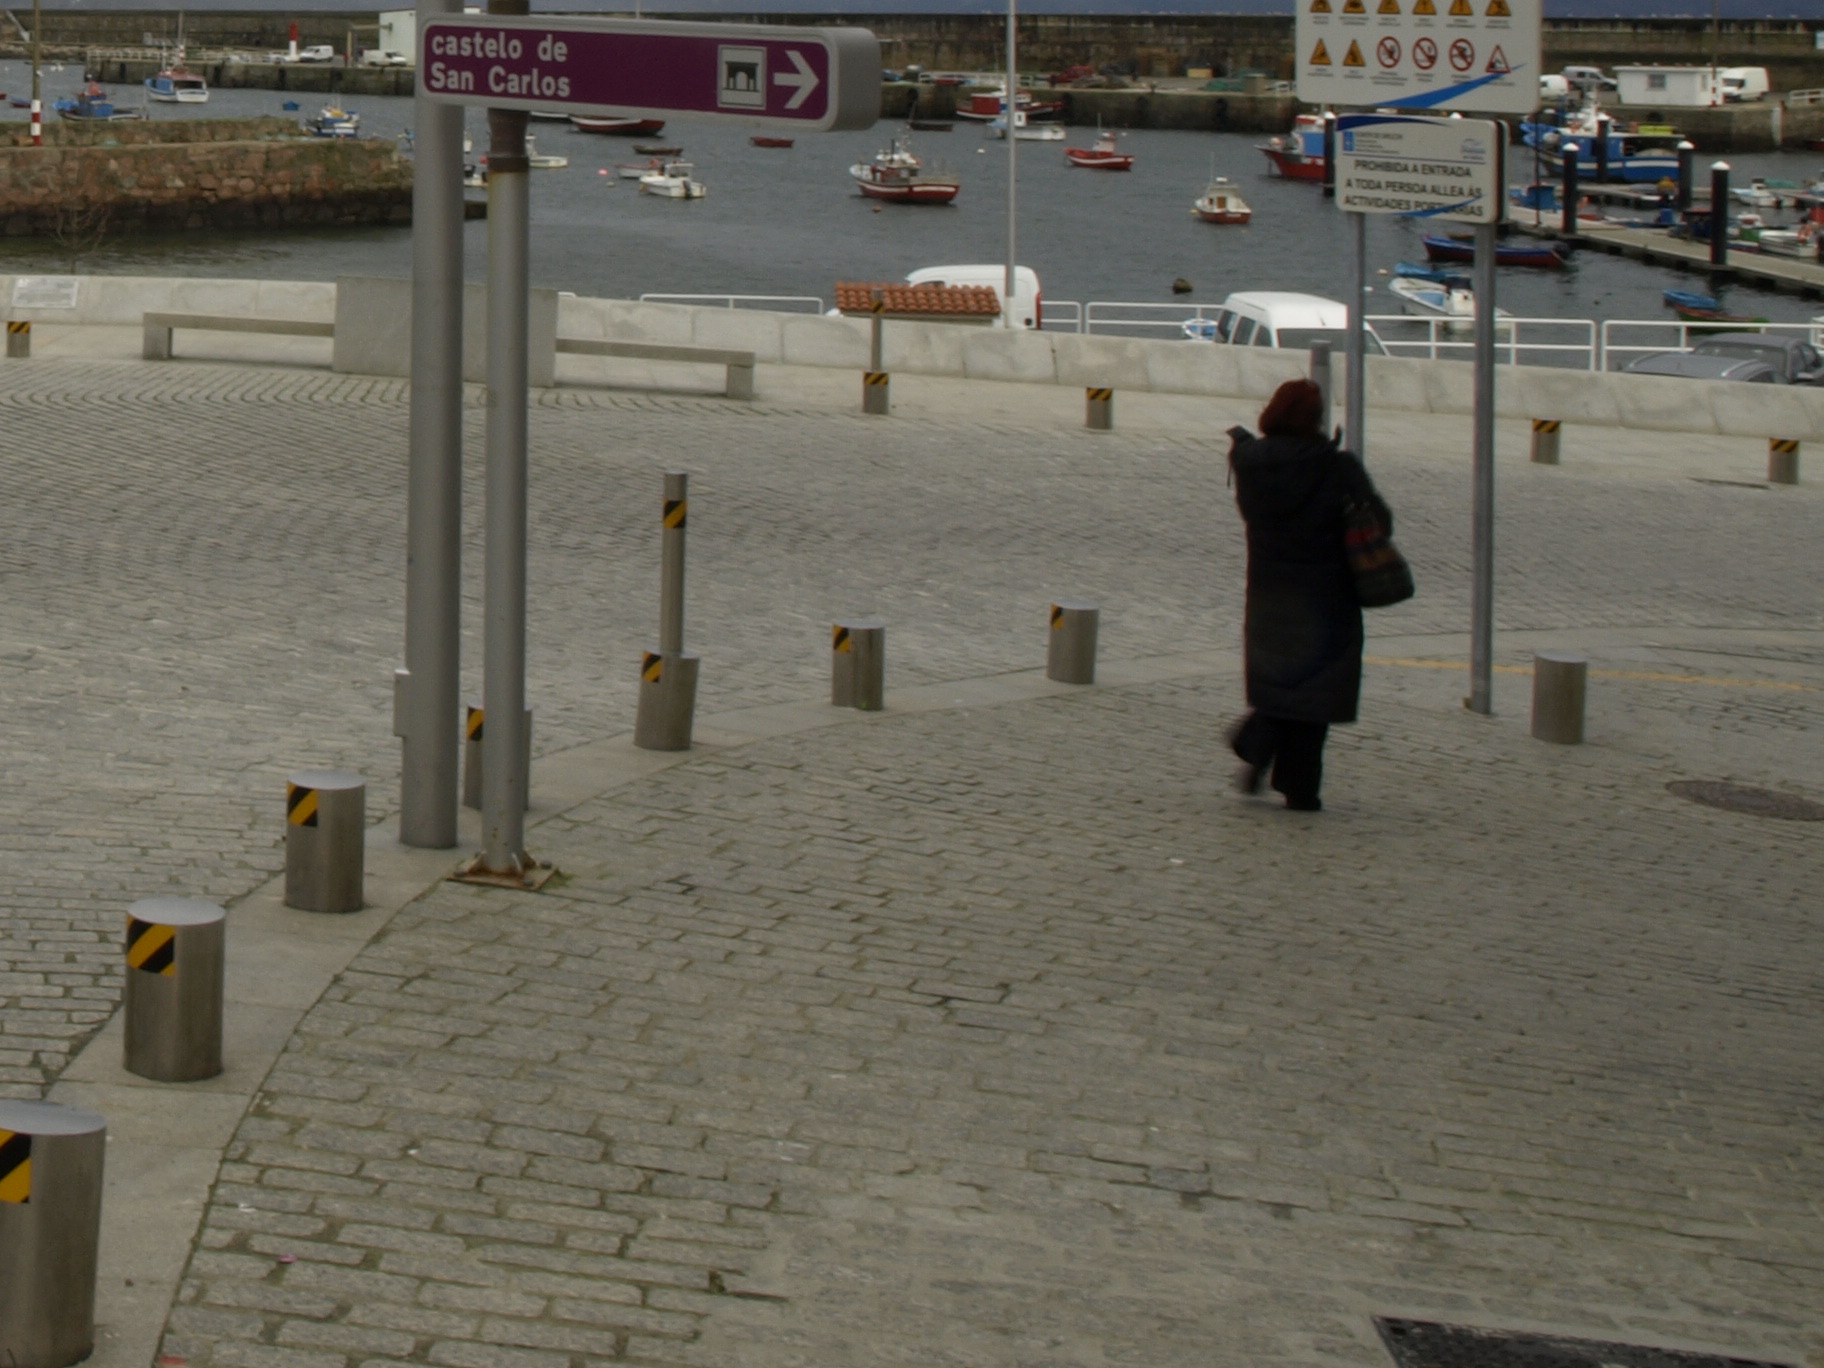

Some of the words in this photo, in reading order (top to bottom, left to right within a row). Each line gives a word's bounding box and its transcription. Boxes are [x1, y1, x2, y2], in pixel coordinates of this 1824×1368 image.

[431, 31, 523, 60] castelo
[537, 34, 568, 63] de
[430, 62, 475, 91] San
[488, 66, 570, 98] Carlos
[1355, 160, 1409, 172] PROHIBIDA
[1412, 164, 1419, 173] A
[1421, 165, 1472, 177] ENTRADA
[1346, 178, 1353, 188] A
[1355, 178, 1382, 190] TODA
[1385, 181, 1427, 194] PERSOA
[1430, 184, 1465, 197] ALLEA
[1344, 196, 1411, 210] ACTIVIDADES
